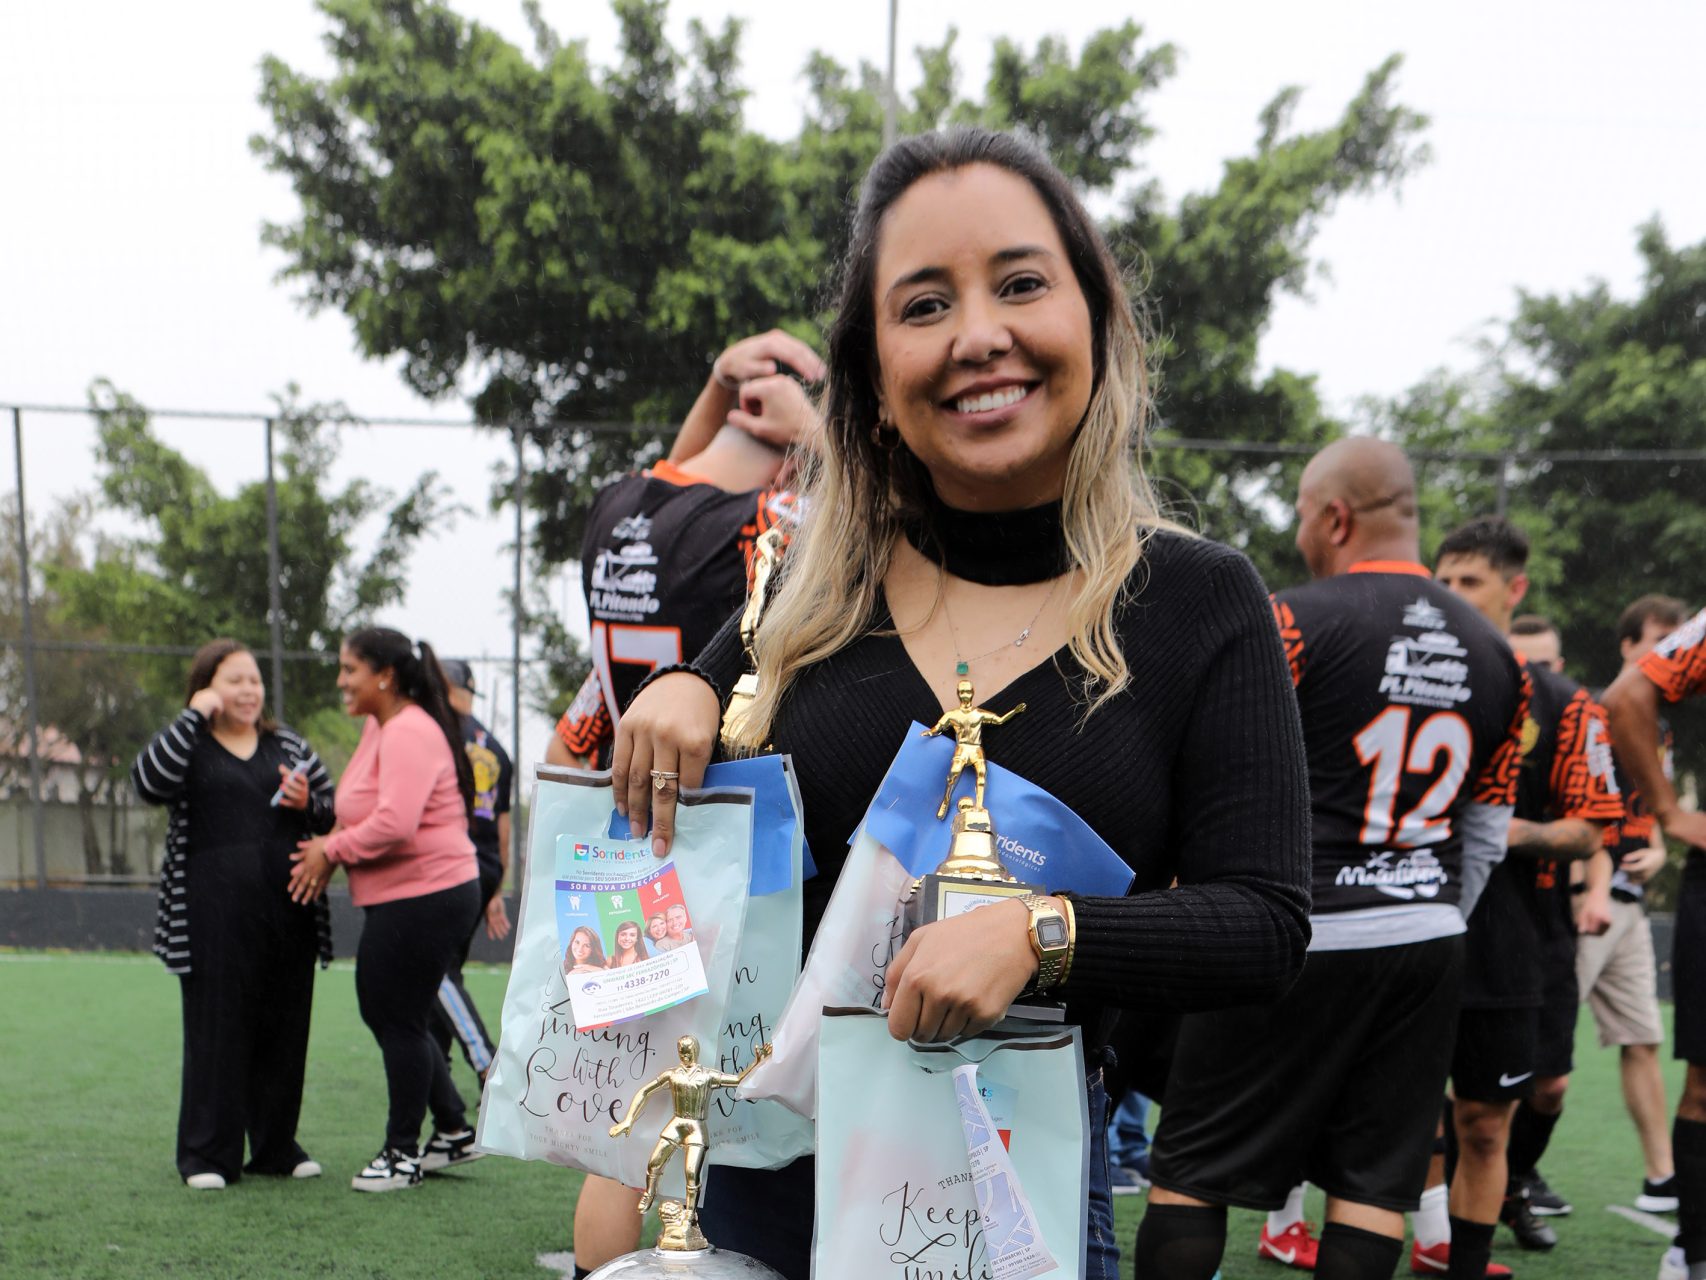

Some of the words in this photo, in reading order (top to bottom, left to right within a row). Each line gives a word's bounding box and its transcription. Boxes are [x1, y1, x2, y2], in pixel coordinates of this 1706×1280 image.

[1352, 704, 1473, 848] 12
[592, 846, 651, 861] Sorridents
[570, 883, 587, 891] SOB
[620, 871, 661, 890] DIREÇÃO
[624, 968, 670, 990] 4338-7270
[551, 1139, 580, 1152] MIGHTY
[880, 1181, 981, 1249] Keep
